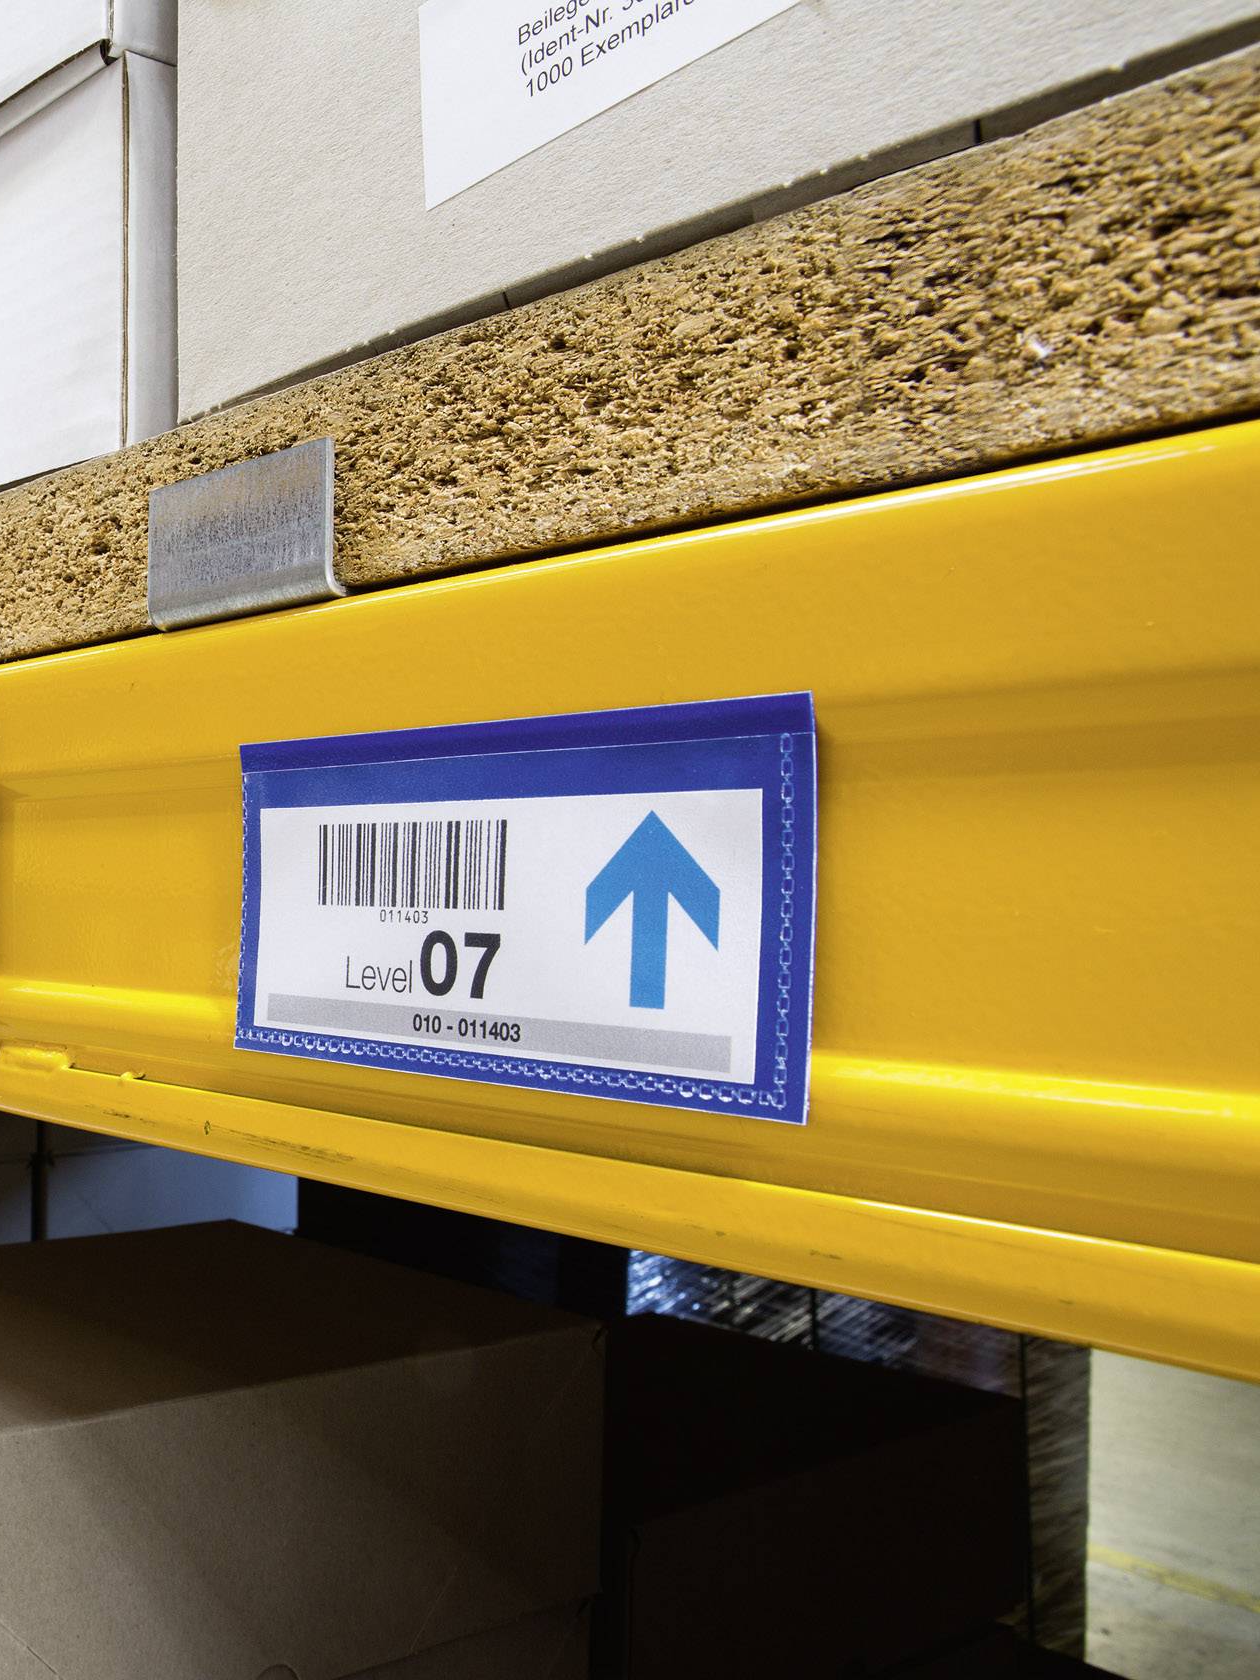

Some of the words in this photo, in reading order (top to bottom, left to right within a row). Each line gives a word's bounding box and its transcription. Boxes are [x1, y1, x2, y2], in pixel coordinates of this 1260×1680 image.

[521, 7, 613, 76] (Ident-Nr.
[526, 56, 573, 98] 1000
[379, 909, 429, 924] 011403
[345, 956, 413, 994] Level
[419, 930, 501, 1000] 07
[412, 1013, 442, 1034] 010
[458, 1018, 521, 1043] 011403
